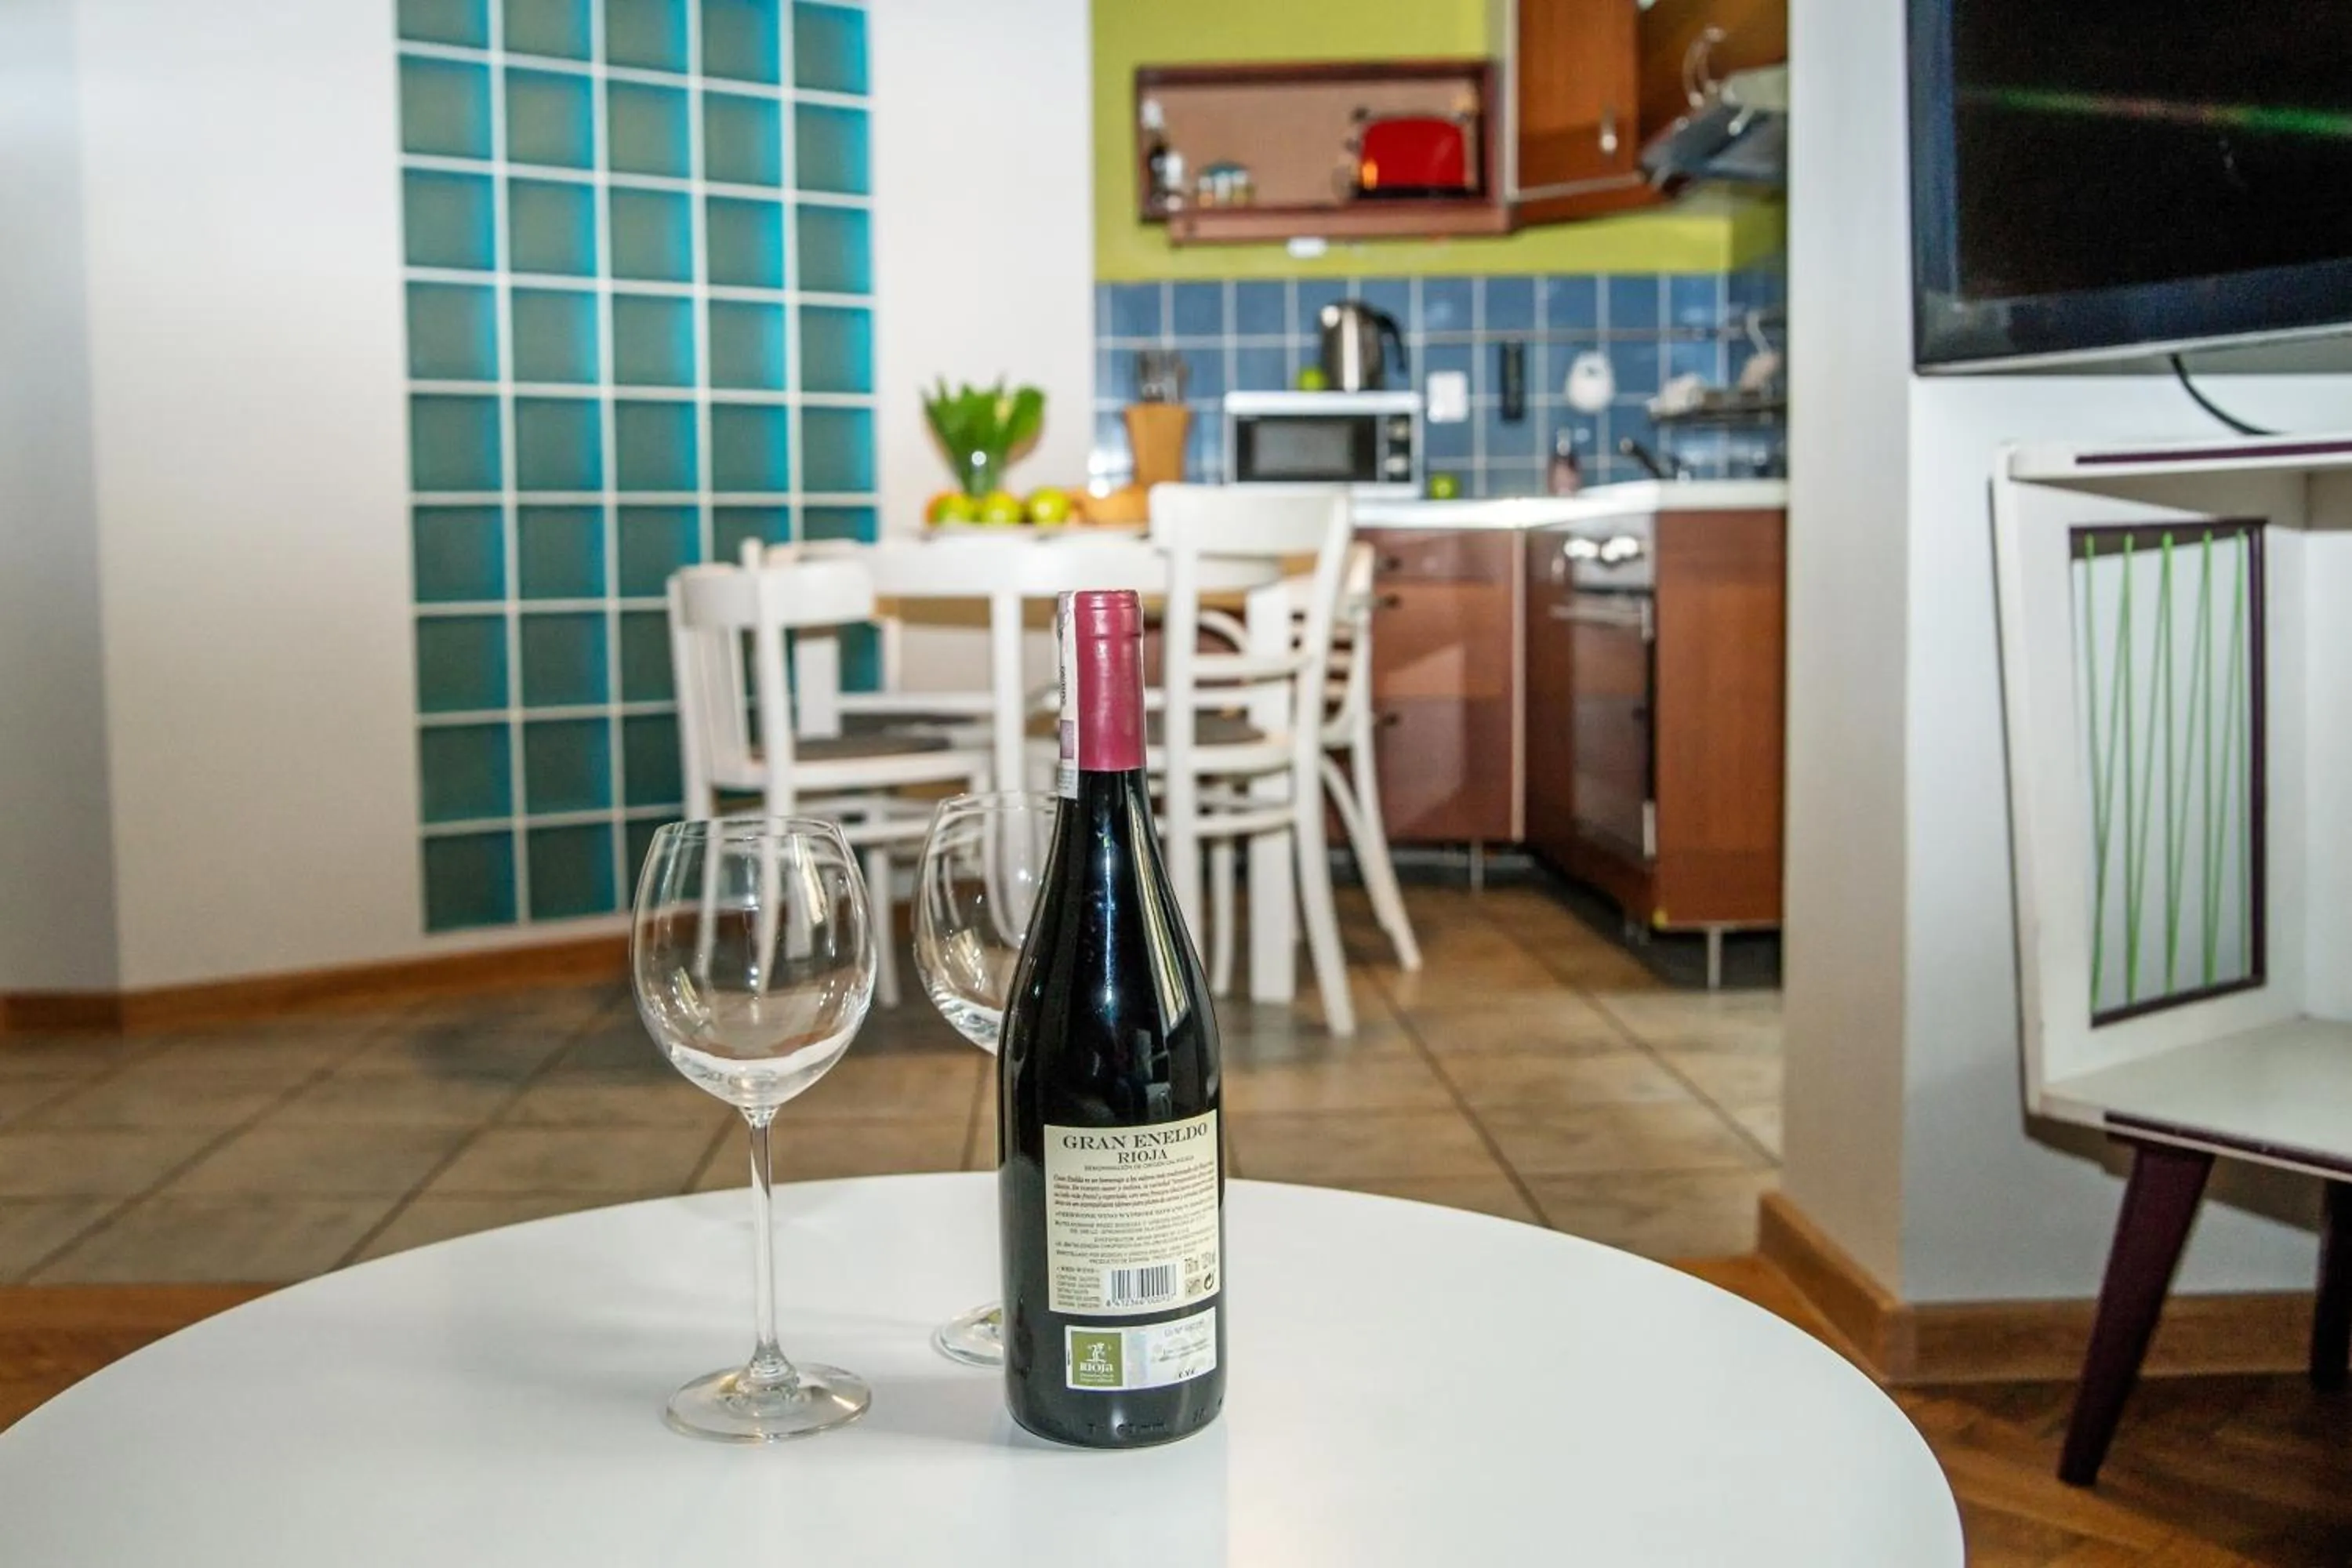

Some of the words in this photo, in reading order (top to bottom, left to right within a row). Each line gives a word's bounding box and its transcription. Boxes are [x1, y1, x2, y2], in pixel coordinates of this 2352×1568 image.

[1062, 1134, 1126, 1150] GRAN
[1134, 1122, 1207, 1149] ENELDO
[1118, 1149, 1167, 1164] RIOJA
